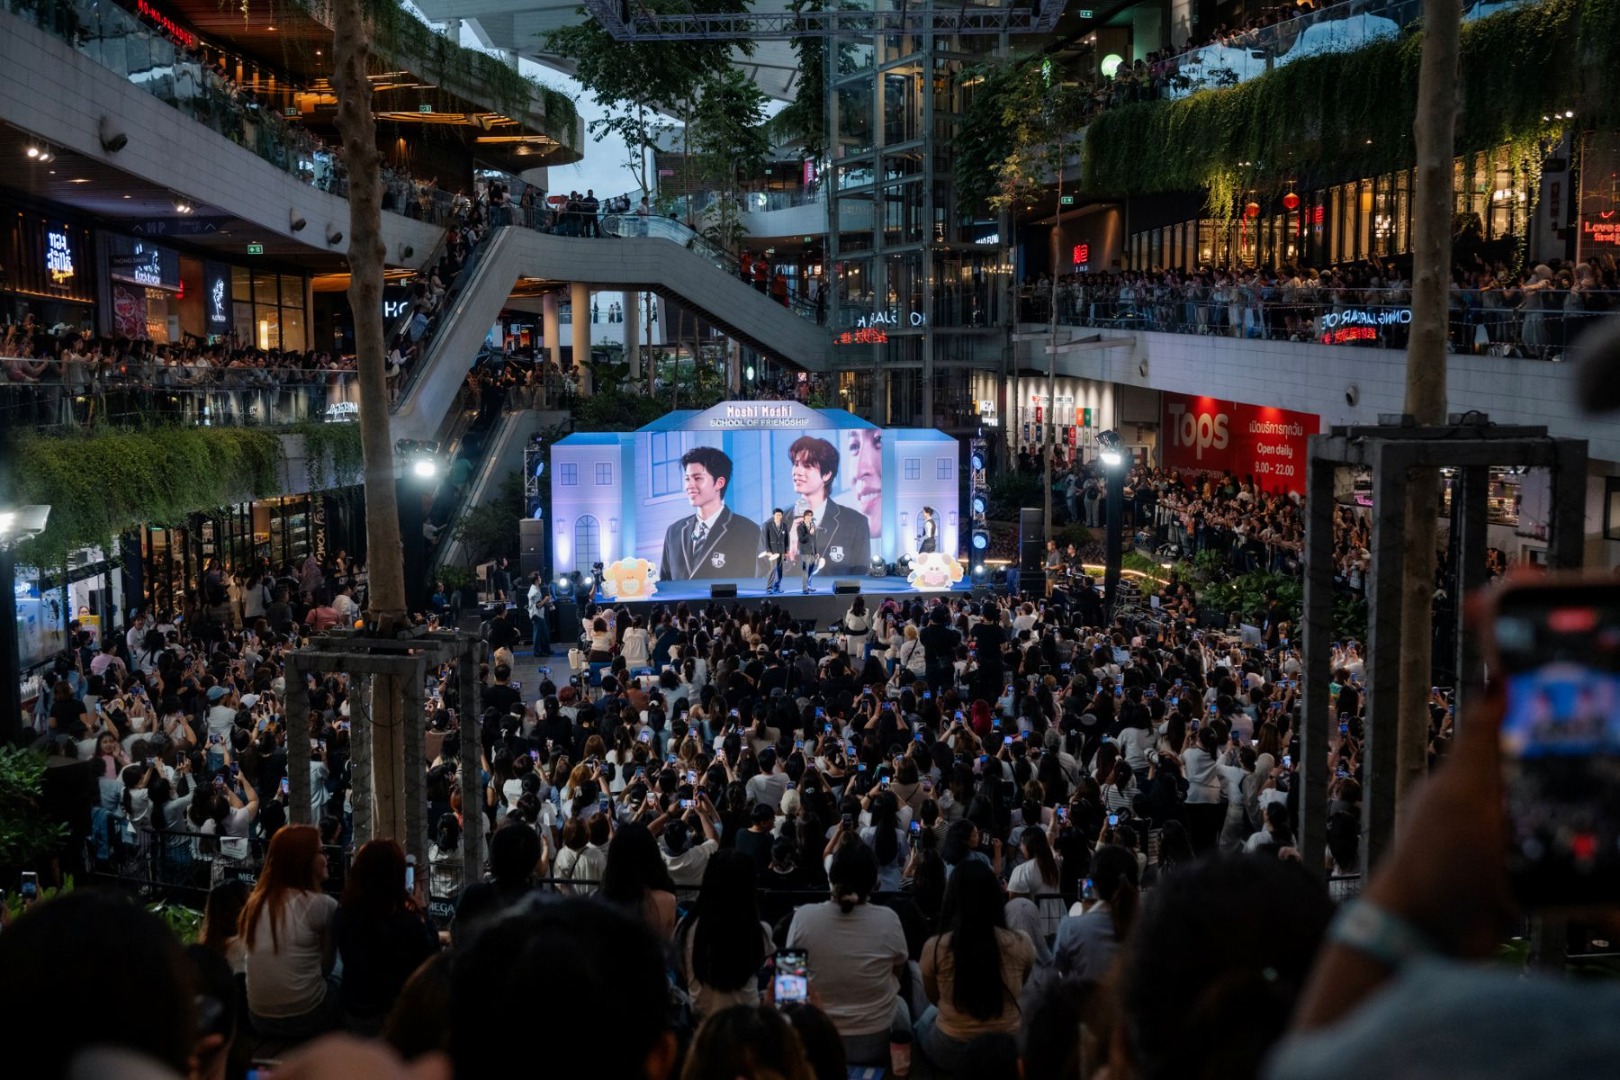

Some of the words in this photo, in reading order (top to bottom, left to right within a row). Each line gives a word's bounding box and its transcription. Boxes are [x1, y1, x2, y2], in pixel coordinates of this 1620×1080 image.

[727, 405, 758, 417] Moshi
[761, 405, 792, 417] Moshi
[710, 418, 746, 427] SCHOOL
[748, 418, 759, 426] OF
[760, 418, 809, 427] FRIENDSHIP
[1168, 403, 1229, 460] Tops
[1257, 442, 1275, 455] Open
[1276, 443, 1293, 459] daily
[1255, 461, 1269, 474] 9.00
[1275, 464, 1294, 476] 22.00
